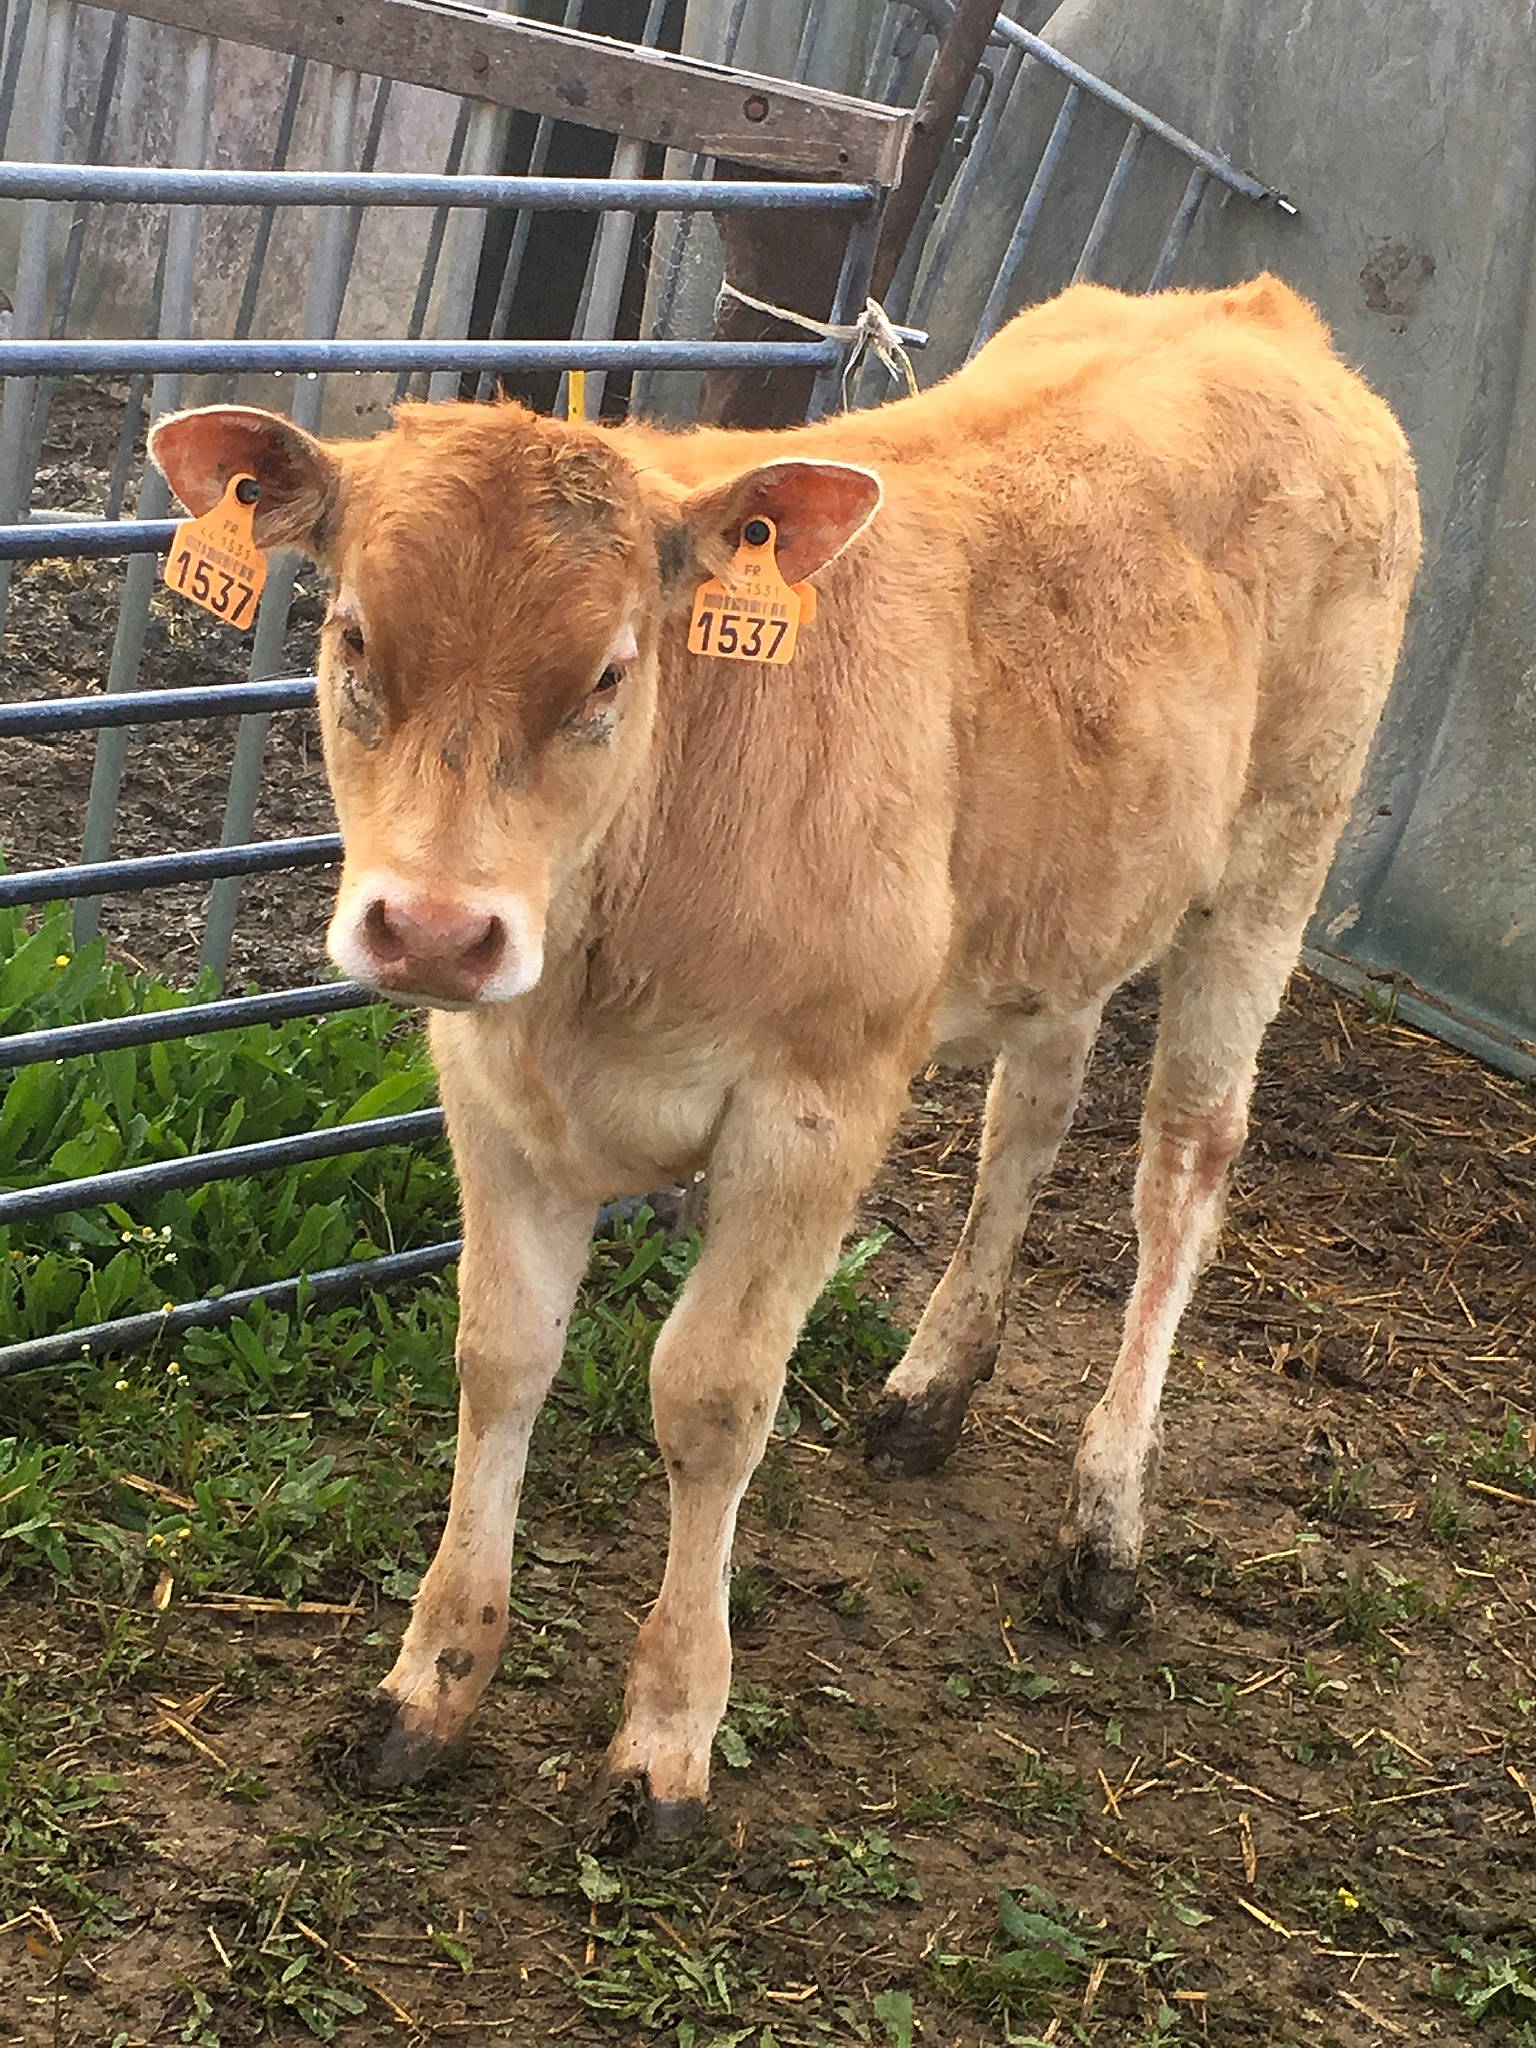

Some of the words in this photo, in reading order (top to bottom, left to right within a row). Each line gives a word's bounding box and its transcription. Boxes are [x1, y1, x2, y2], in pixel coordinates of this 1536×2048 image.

[177, 550, 254, 621] 1537
[744, 564, 761, 577] FR
[697, 611, 788, 659] 1537
